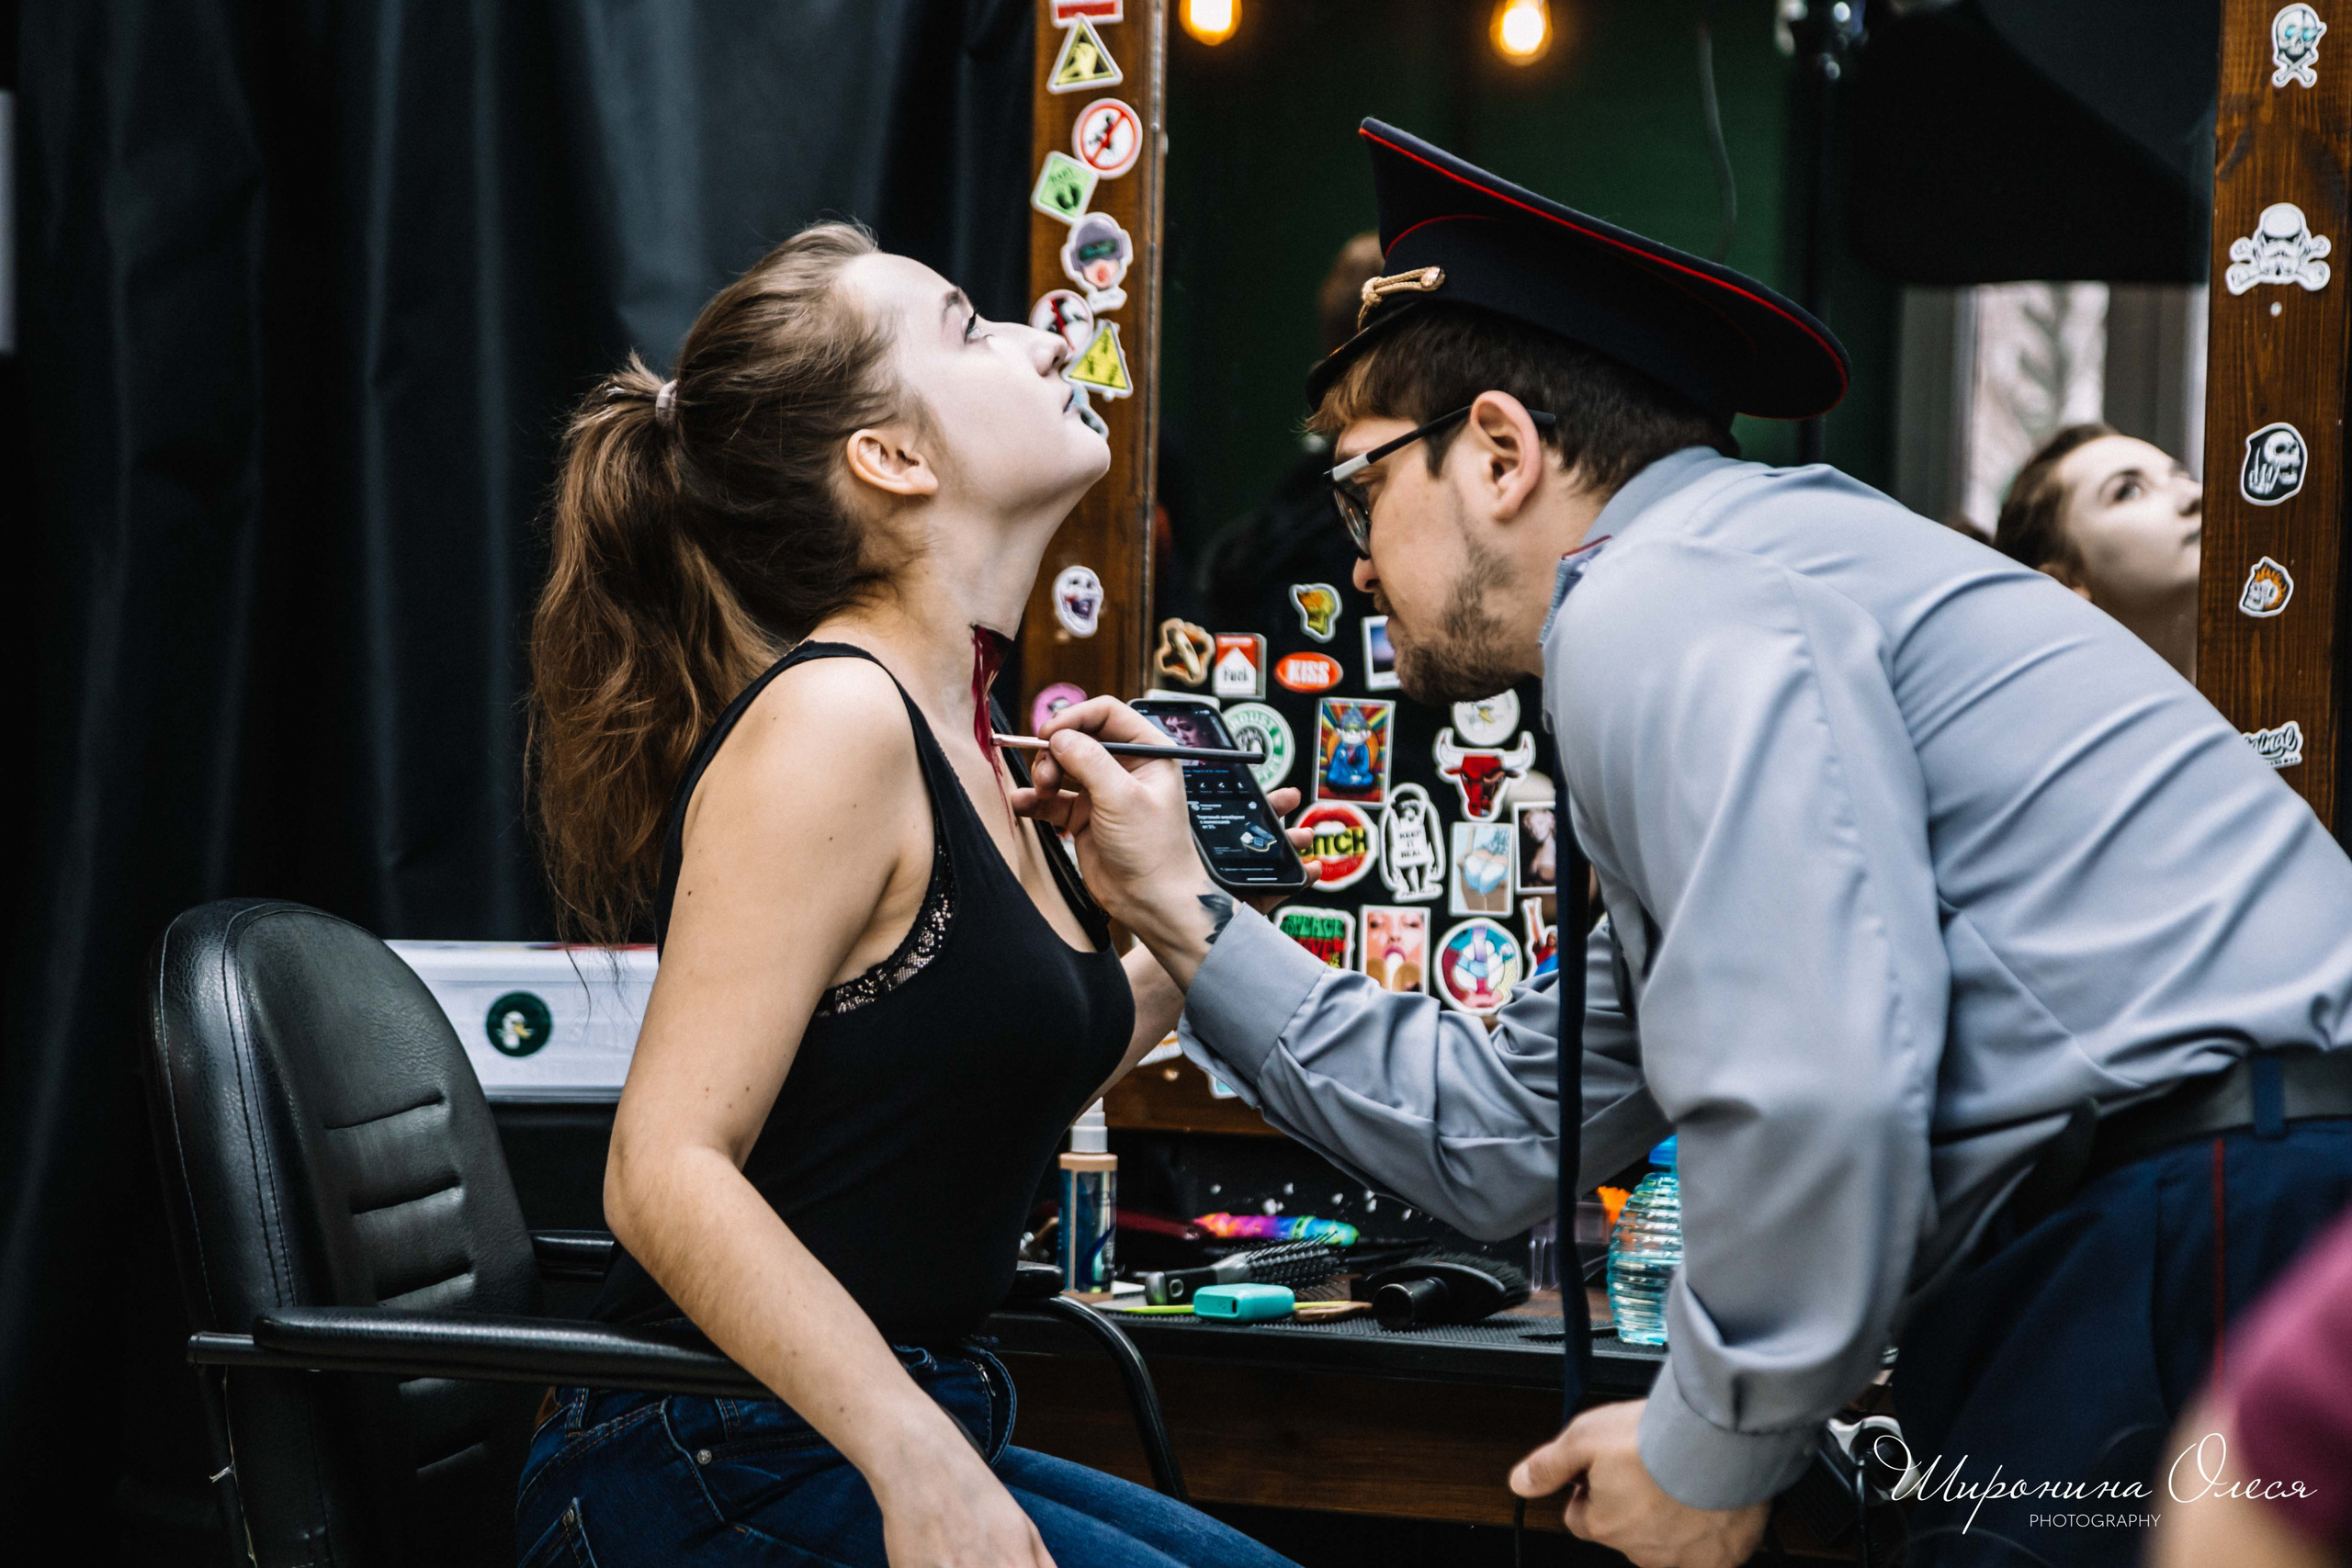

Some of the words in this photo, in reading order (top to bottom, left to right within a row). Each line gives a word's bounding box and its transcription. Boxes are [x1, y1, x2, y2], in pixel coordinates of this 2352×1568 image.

[1224, 666, 1249, 682] Fuck
[1287, 659, 1330, 687] KISS
[1399, 829, 1421, 839] KEEP
[1401, 850, 1421, 858] REAL
